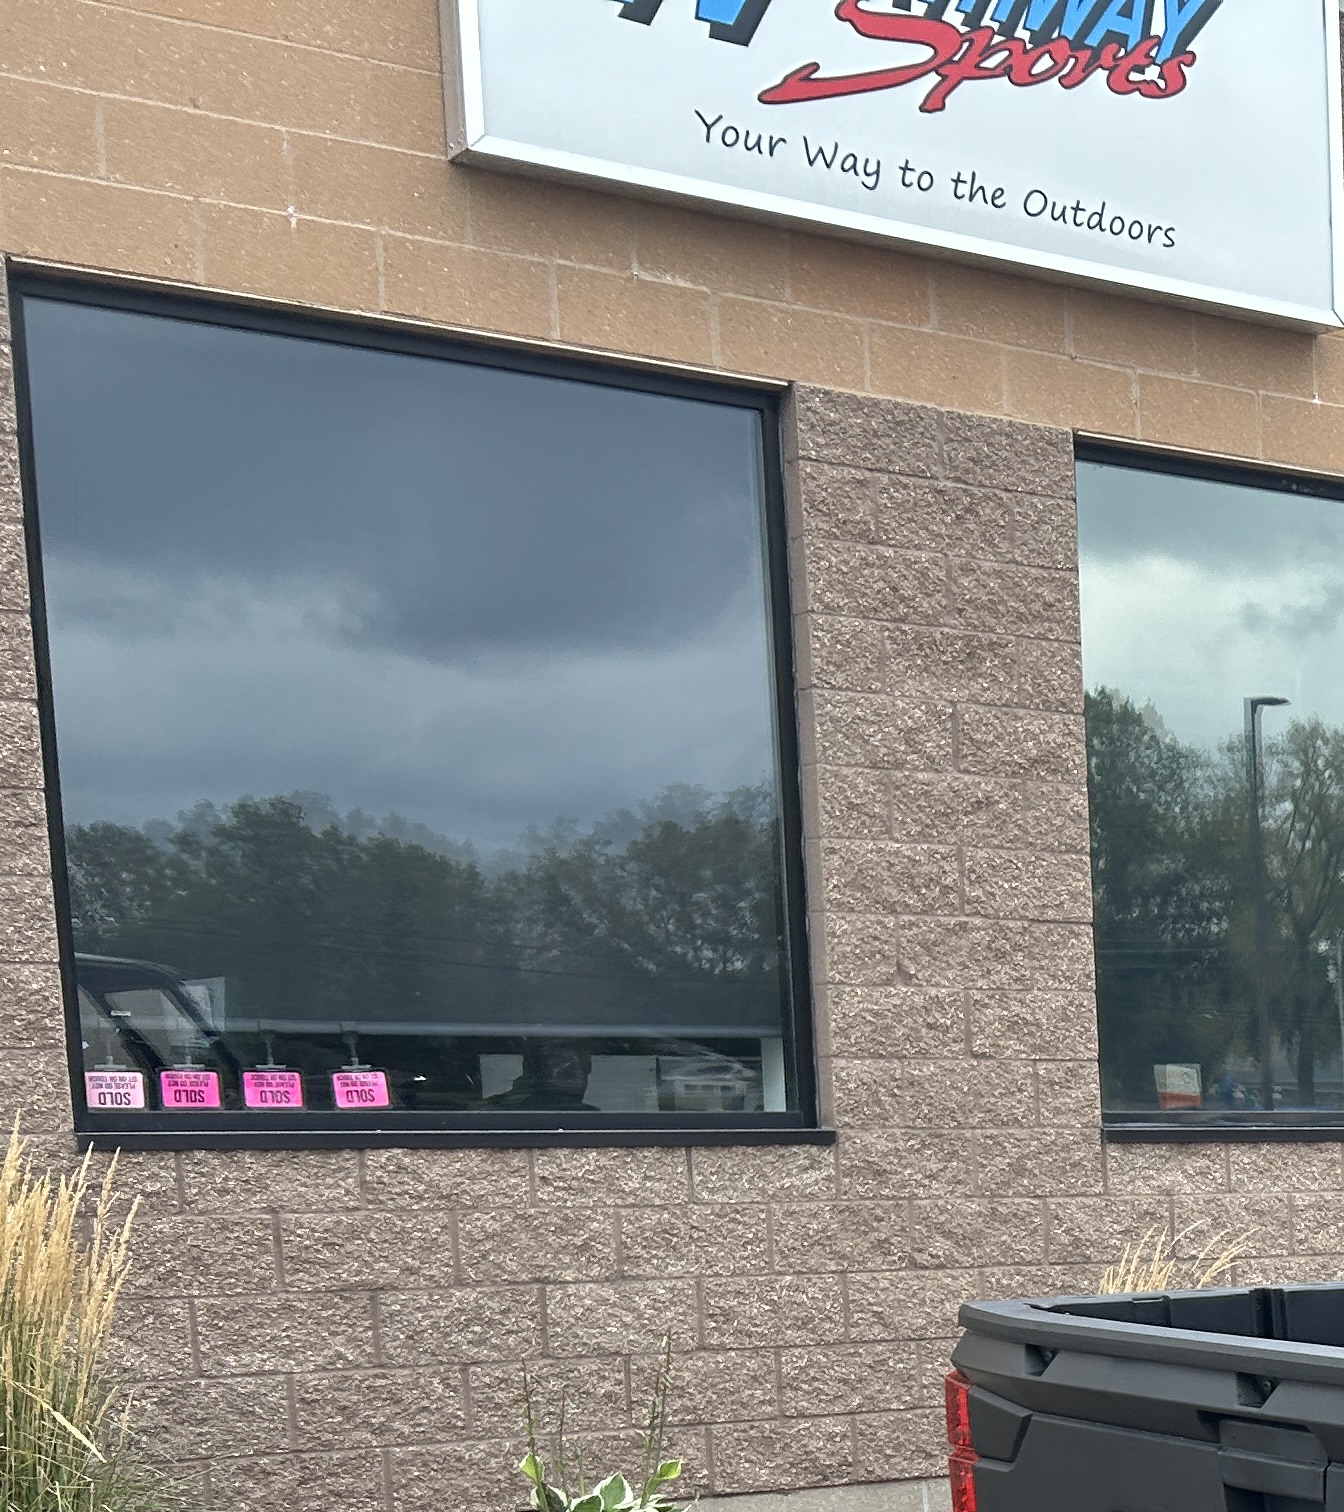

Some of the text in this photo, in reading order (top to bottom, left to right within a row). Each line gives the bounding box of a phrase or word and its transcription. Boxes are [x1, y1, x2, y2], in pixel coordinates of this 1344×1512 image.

[757, 0, 1197, 111] Sports
[695, 109, 1176, 248] Your Way to the Outdoors
[98, 1091, 131, 1106] SOLD
[173, 1089, 205, 1103] SOLD
[260, 1090, 291, 1103] SOLD
[346, 1089, 376, 1103] SOLD
